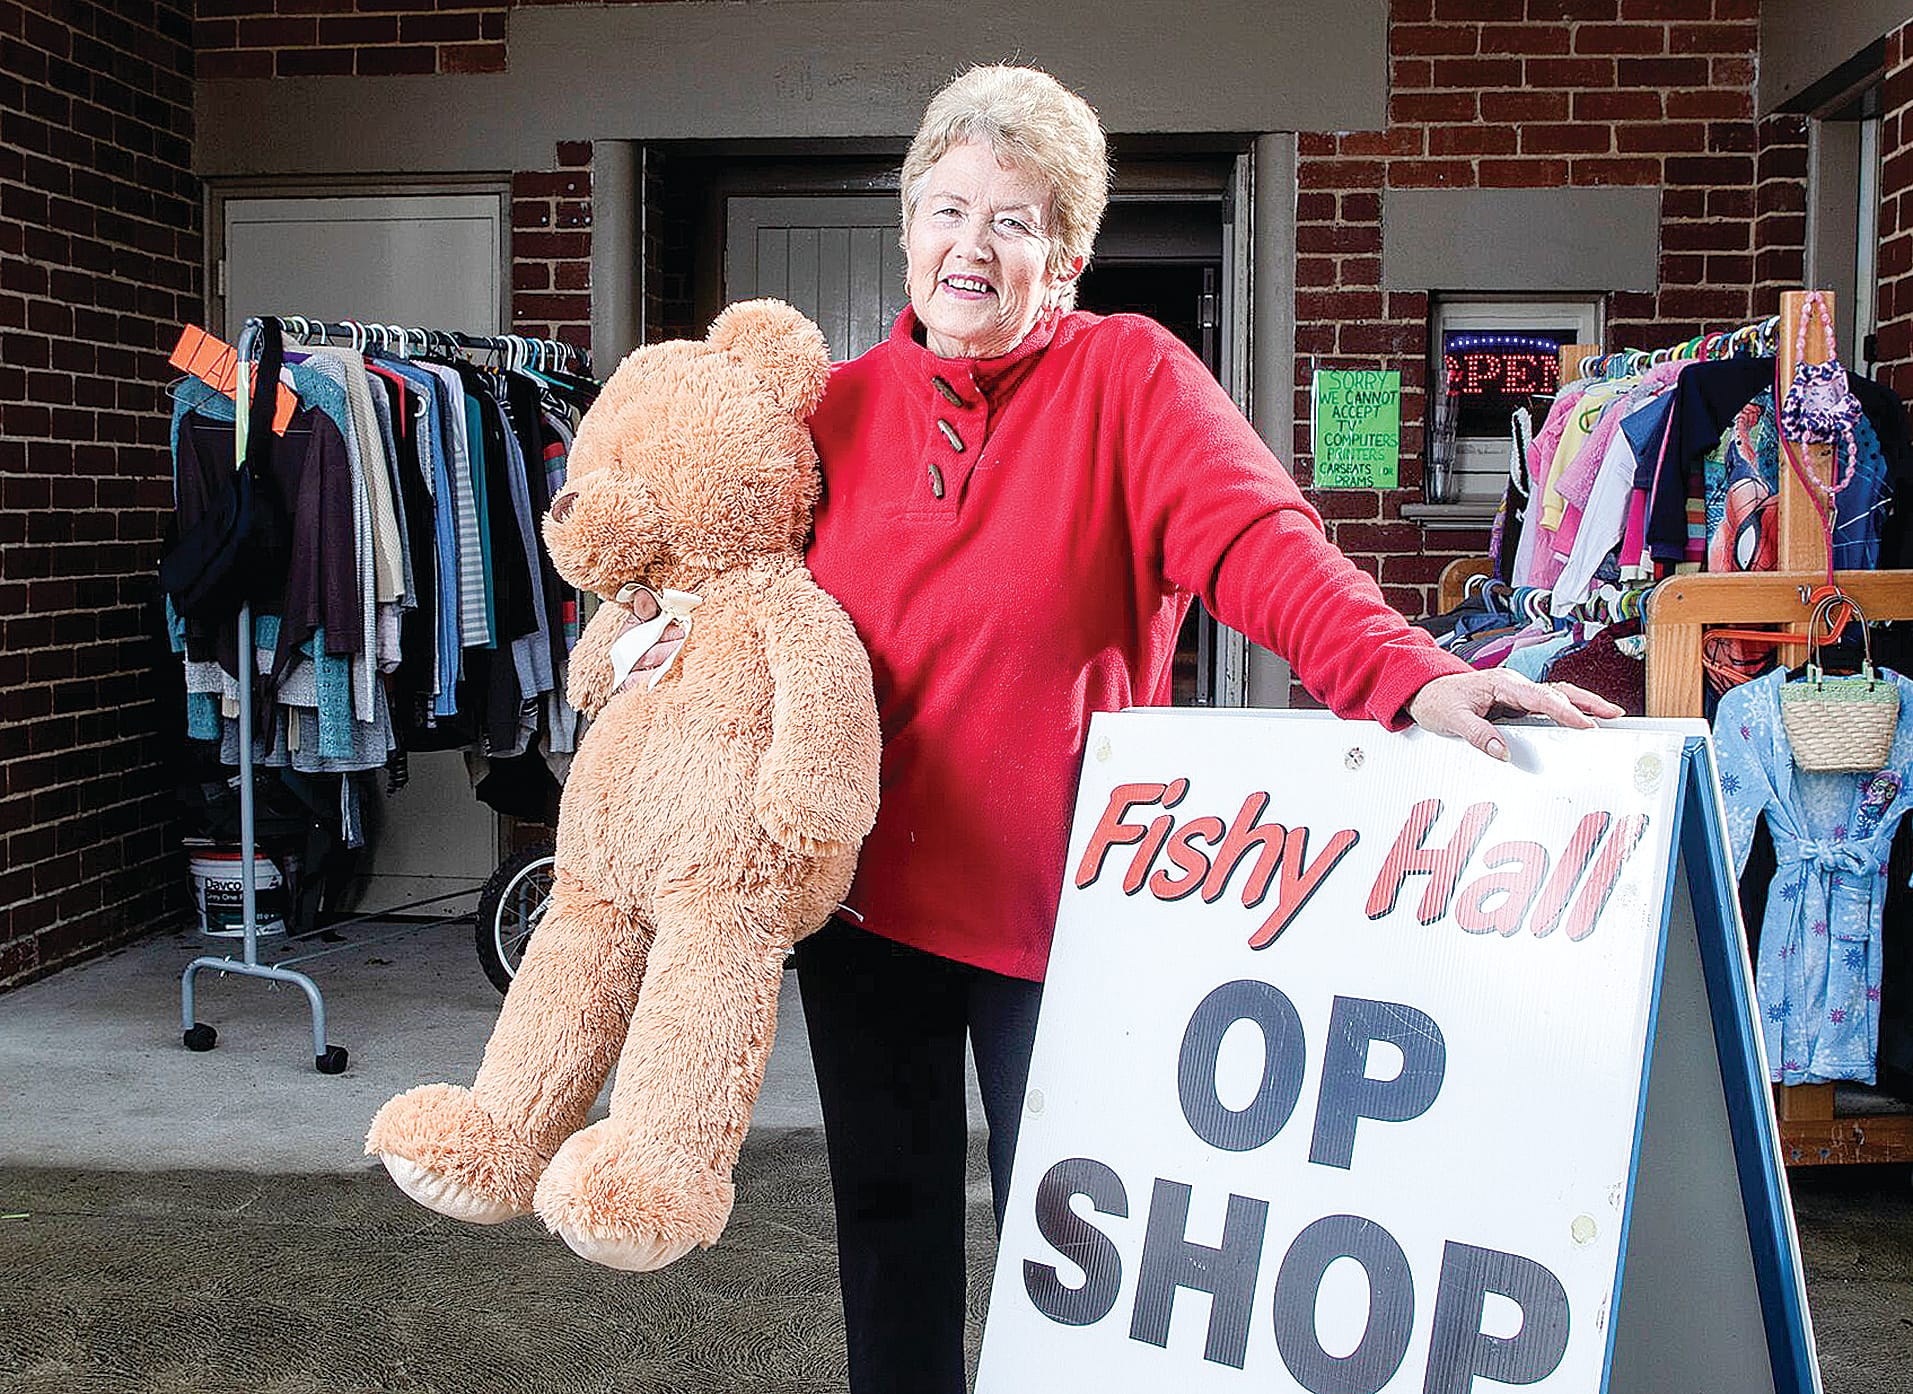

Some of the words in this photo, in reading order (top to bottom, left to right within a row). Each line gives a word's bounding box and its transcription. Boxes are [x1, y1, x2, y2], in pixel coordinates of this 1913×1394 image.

[1328, 371, 1389, 390] SORRY
[1319, 391, 1340, 404] WE
[1345, 390, 1398, 405] CANNOT
[1332, 405, 1381, 419] ACCEPT
[1324, 433, 1400, 447] COMPUTERS
[1327, 448, 1385, 461] PRINTERS
[1319, 462, 1372, 475] CARSEATS
[1335, 475, 1374, 487] PRAMS
[1075, 778, 1359, 951] Fishy
[1365, 798, 1650, 942] Hall
[205, 878, 242, 891] Davco
[1178, 979, 1446, 1170] OP
[1023, 1158, 1570, 1394] SHOP
